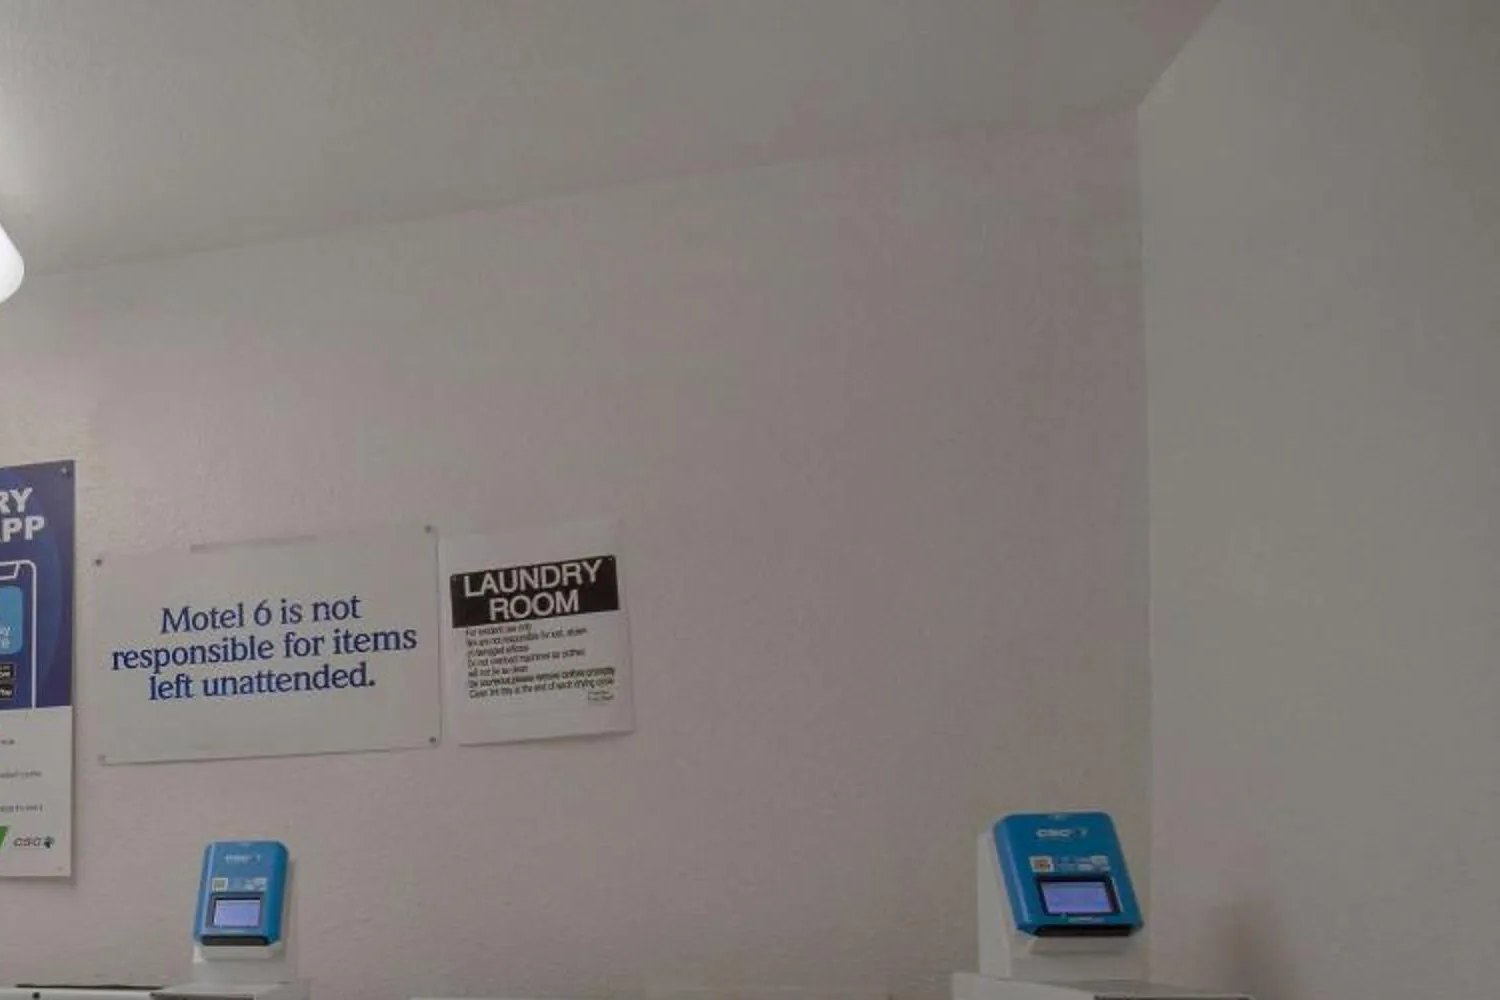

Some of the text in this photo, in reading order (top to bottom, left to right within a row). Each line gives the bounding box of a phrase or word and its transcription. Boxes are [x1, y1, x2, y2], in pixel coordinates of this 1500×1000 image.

[463, 559, 603, 598] LAUNDRY
[161, 595, 361, 634] Motel 6 is not
[489, 589, 580, 621] ROOM
[111, 627, 418, 672] responsible for items
[149, 662, 376, 701] left unattended.
